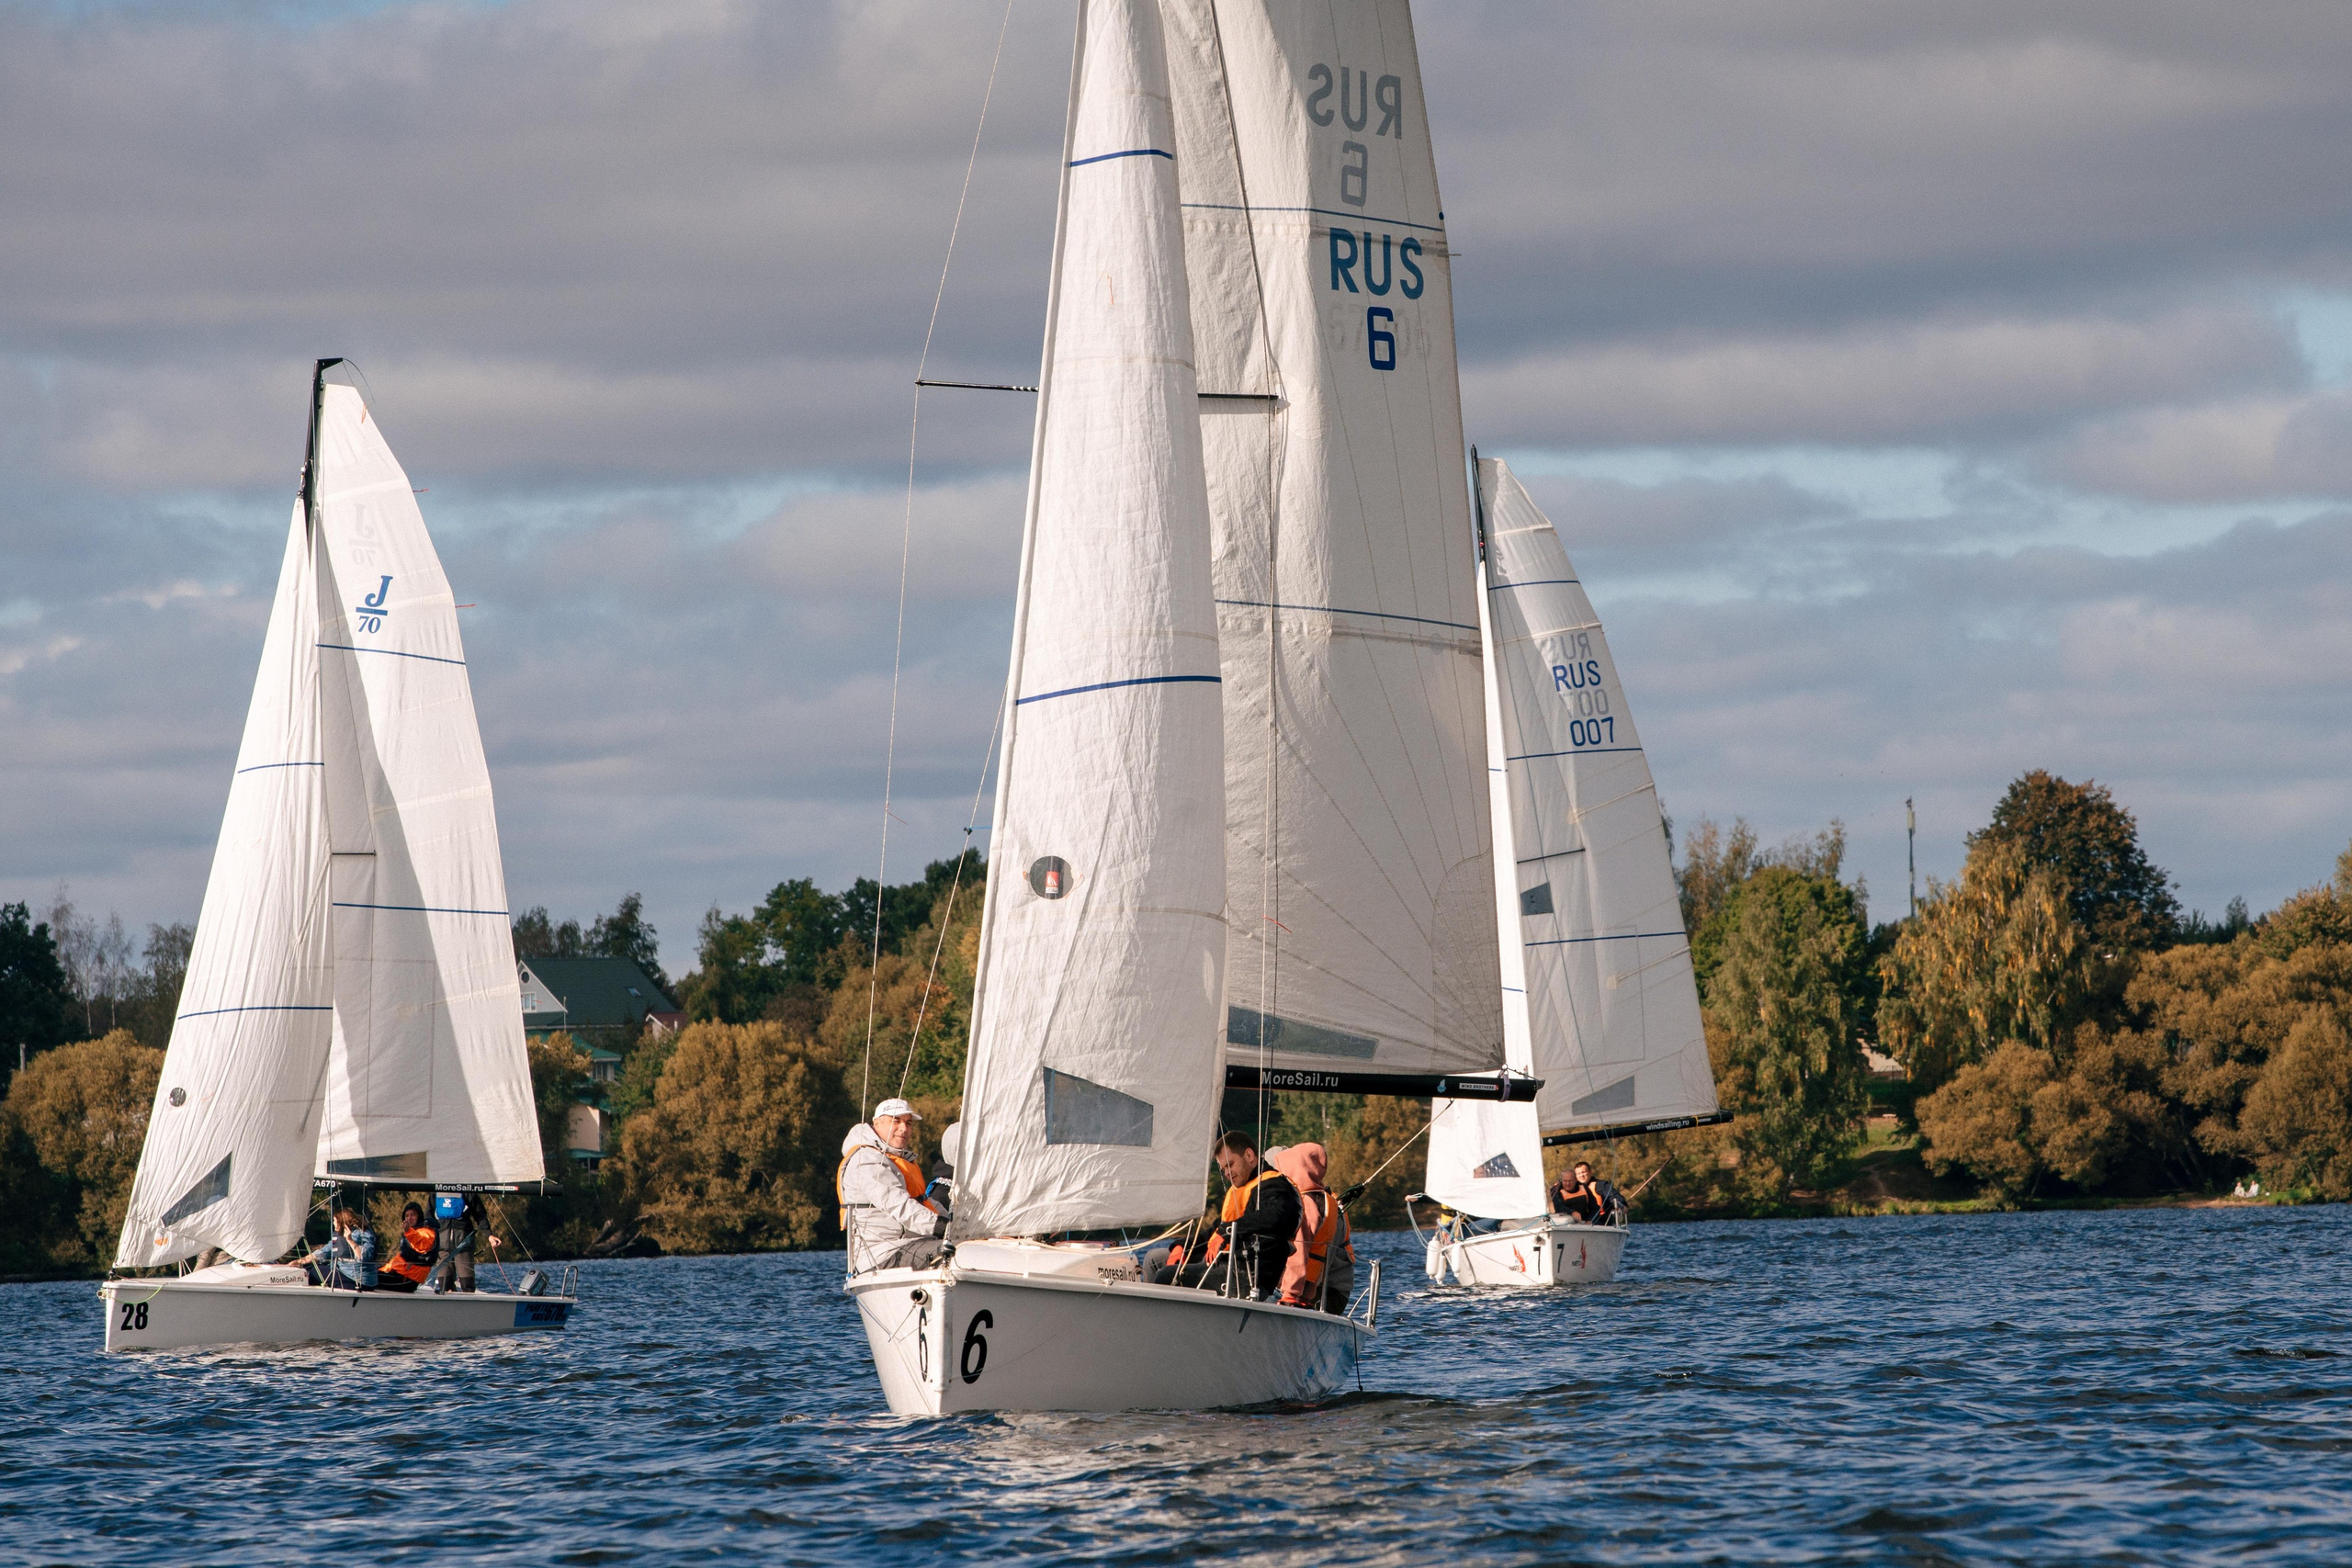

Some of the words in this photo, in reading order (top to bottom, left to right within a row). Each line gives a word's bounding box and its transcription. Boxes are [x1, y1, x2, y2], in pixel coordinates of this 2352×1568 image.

[1329, 227, 1425, 300] RUS
[1367, 306, 1396, 371] 6
[365, 575, 394, 607] J
[357, 615, 381, 634] 70
[1552, 660, 1601, 692] RUS
[1569, 716, 1614, 747] 007
[1261, 1070, 1339, 1088] MoreSail.ru
[1645, 1119, 1690, 1131] windsailing.ru
[1533, 1247, 1541, 1275] 7
[1556, 1243, 1565, 1273] 7
[270, 1276, 304, 1284] MoreSail.ru
[1097, 1265, 1136, 1282] moresail.ru
[120, 1301, 150, 1331] 28
[919, 1307, 928, 1382] 6
[961, 1309, 993, 1384] 6
